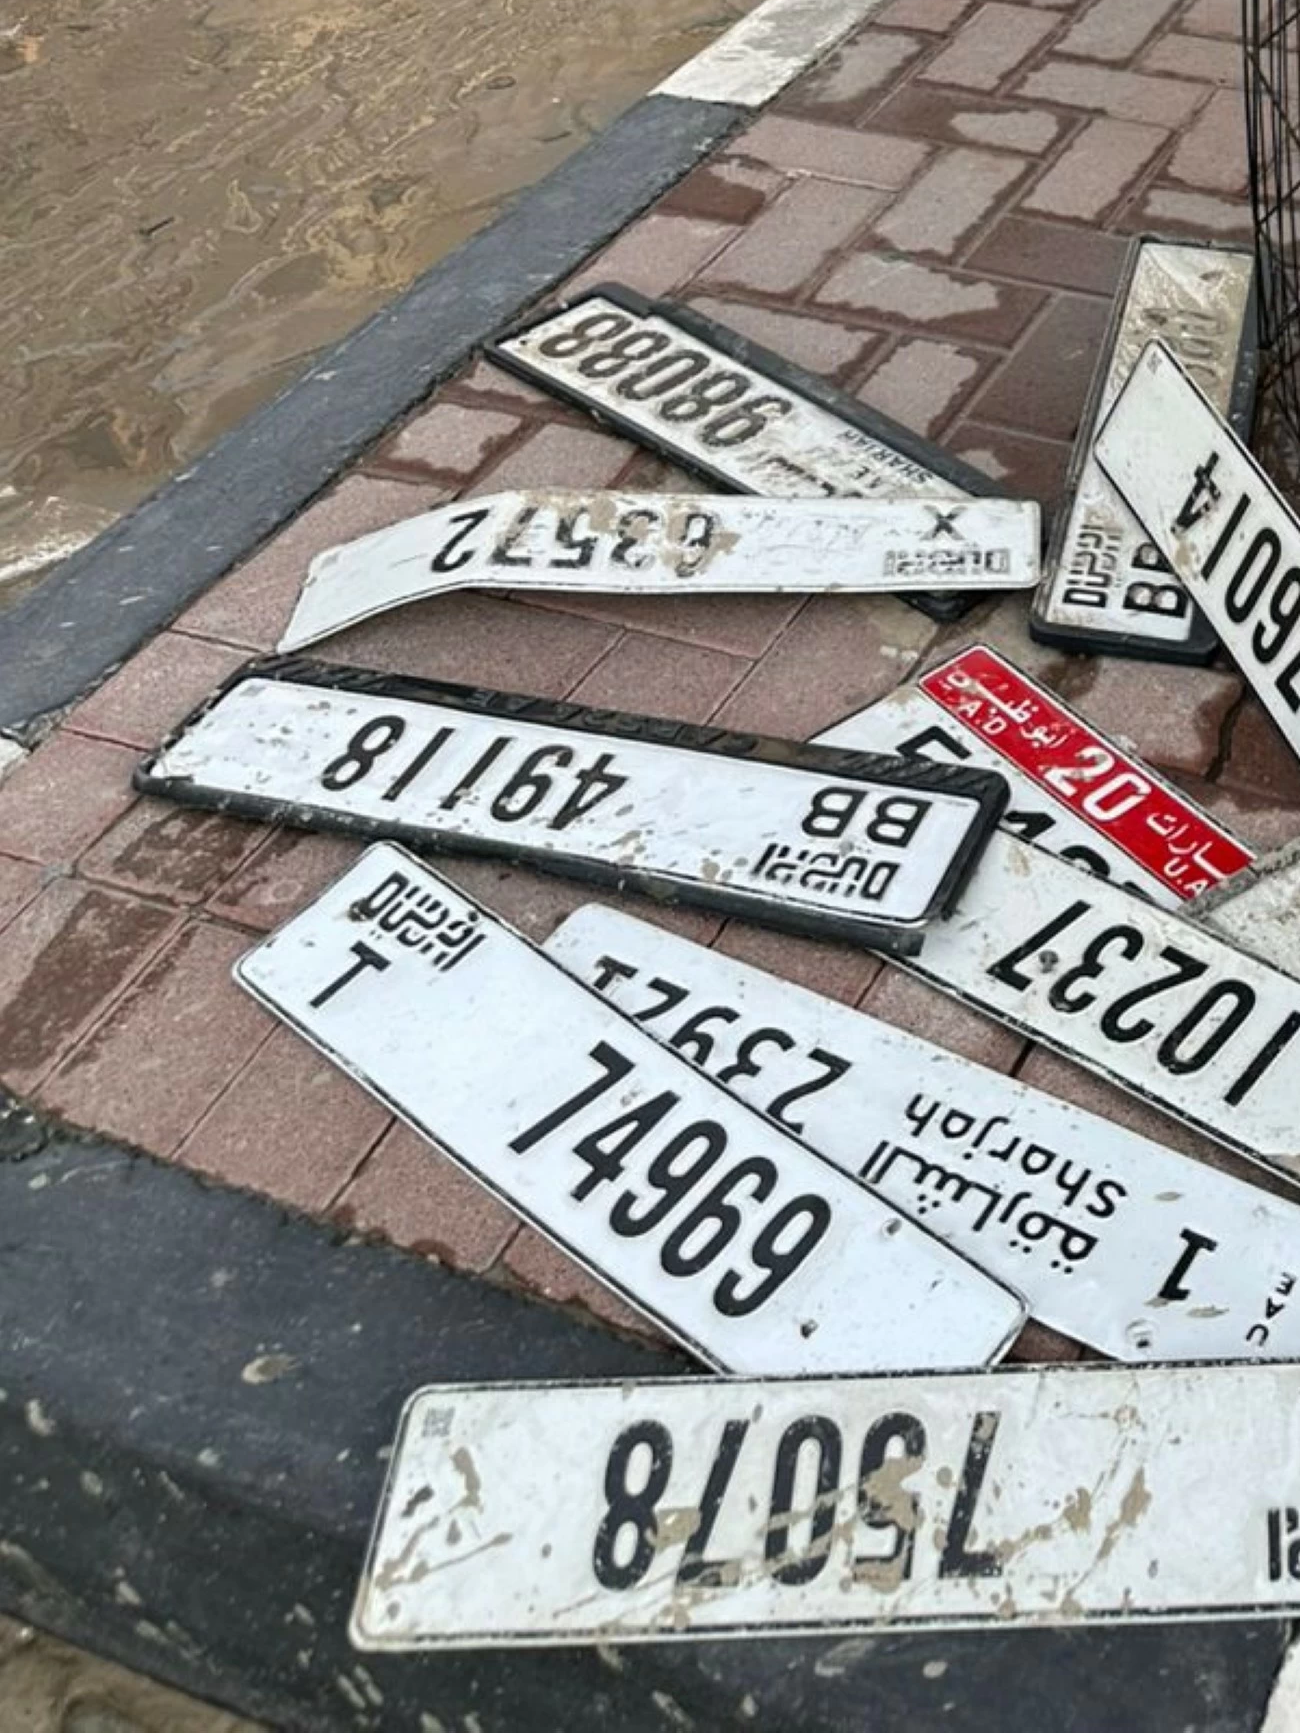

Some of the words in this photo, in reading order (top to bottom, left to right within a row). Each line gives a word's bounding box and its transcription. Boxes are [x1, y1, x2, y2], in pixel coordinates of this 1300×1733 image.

[538, 312, 793, 448] 98088
[920, 504, 967, 541] X
[321, 714, 633, 830] 49118
[801, 784, 934, 848] BB
[1043, 745, 1152, 823] 20
[750, 842, 900, 902] DUBAI
[352, 870, 487, 973] DUBAI
[310, 939, 392, 1008] T
[507, 1039, 832, 1318] 74969
[903, 1092, 1128, 1219] Sharjah
[858, 1139, 1100, 1274] الشارقة
[1158, 1227, 1219, 1302] 1
[1245, 1270, 1298, 1347] UAE
[592, 1410, 1002, 1591] 75078
